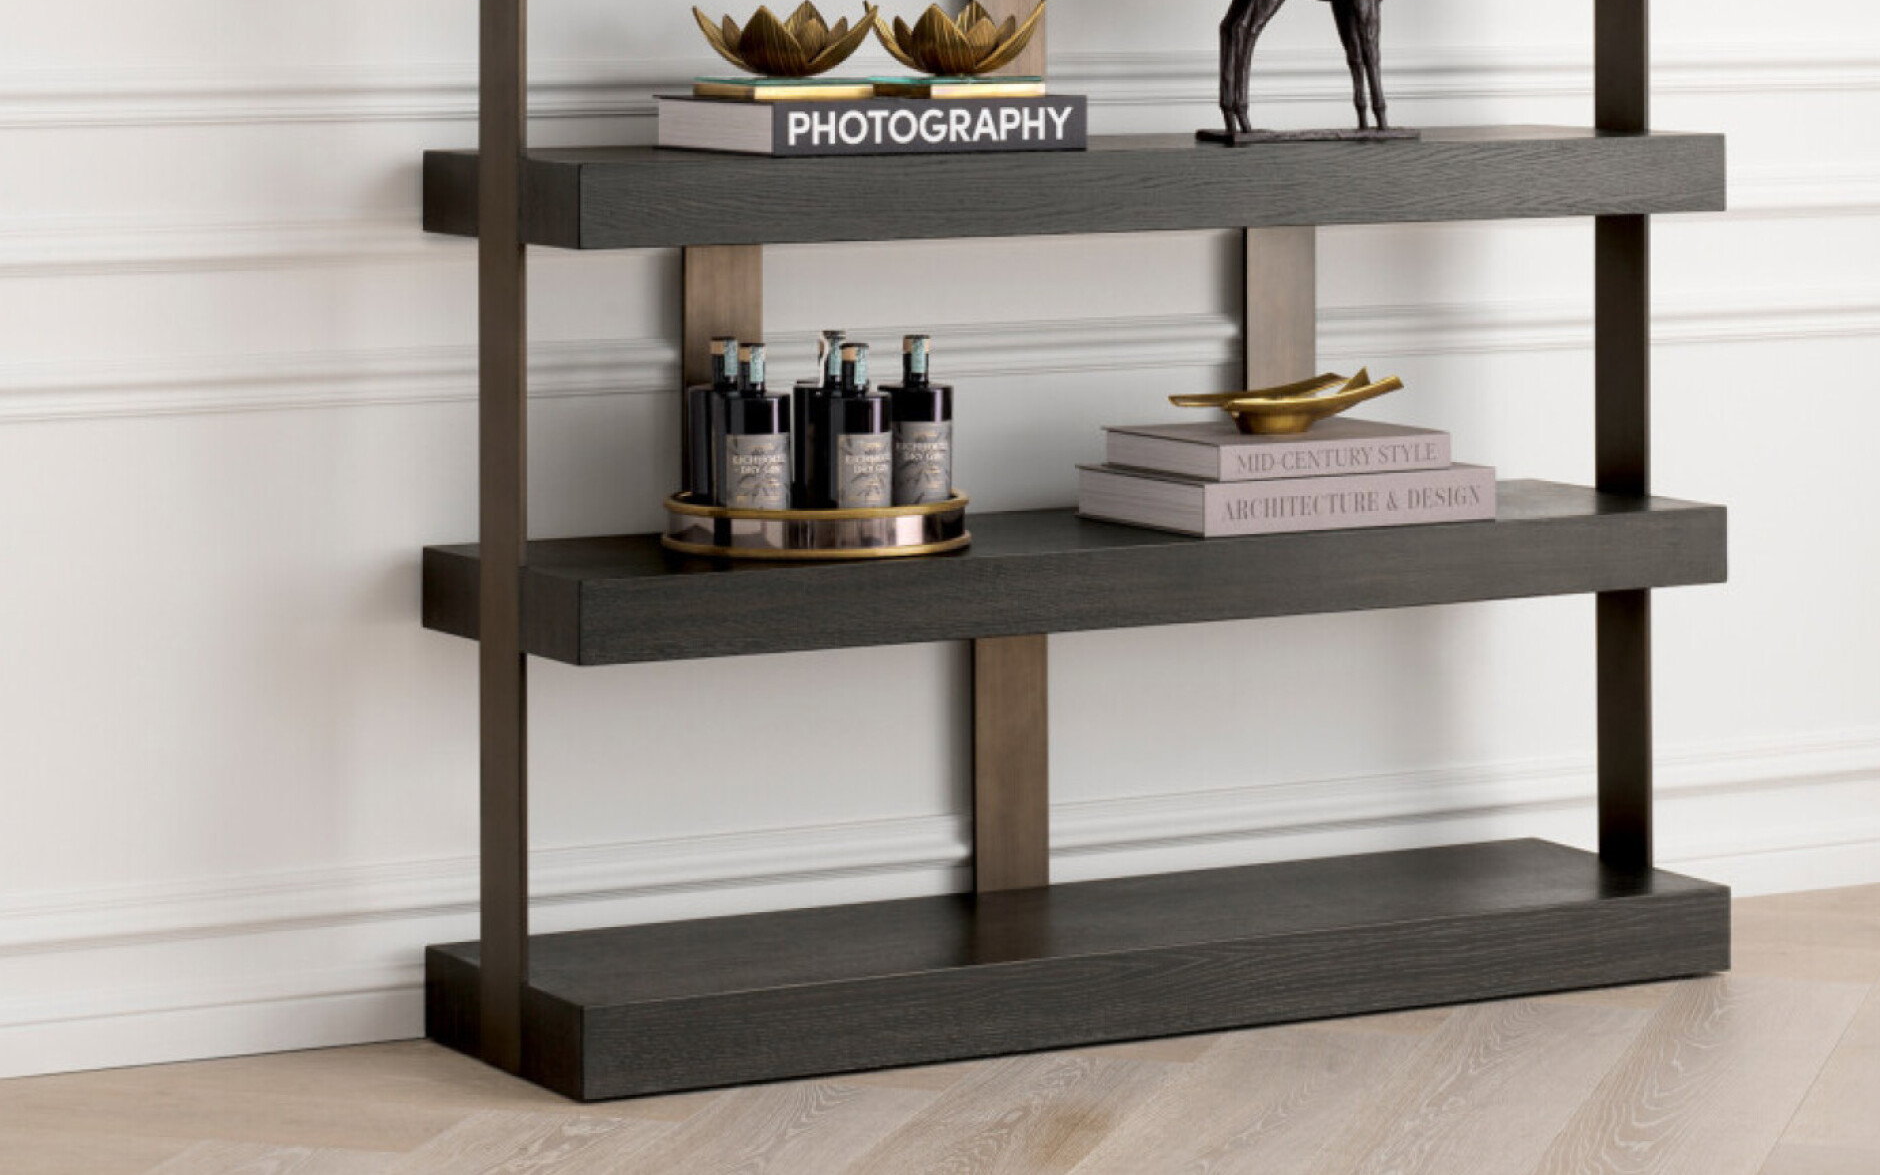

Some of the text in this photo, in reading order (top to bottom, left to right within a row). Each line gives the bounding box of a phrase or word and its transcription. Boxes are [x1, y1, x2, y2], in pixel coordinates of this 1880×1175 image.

[787, 106, 1073, 146] PHOTOGRAPHY
[1237, 443, 1437, 473] MID-CENTURY STYLE
[1226, 485, 1481, 520] ARCHITECTURE & DESIGN
